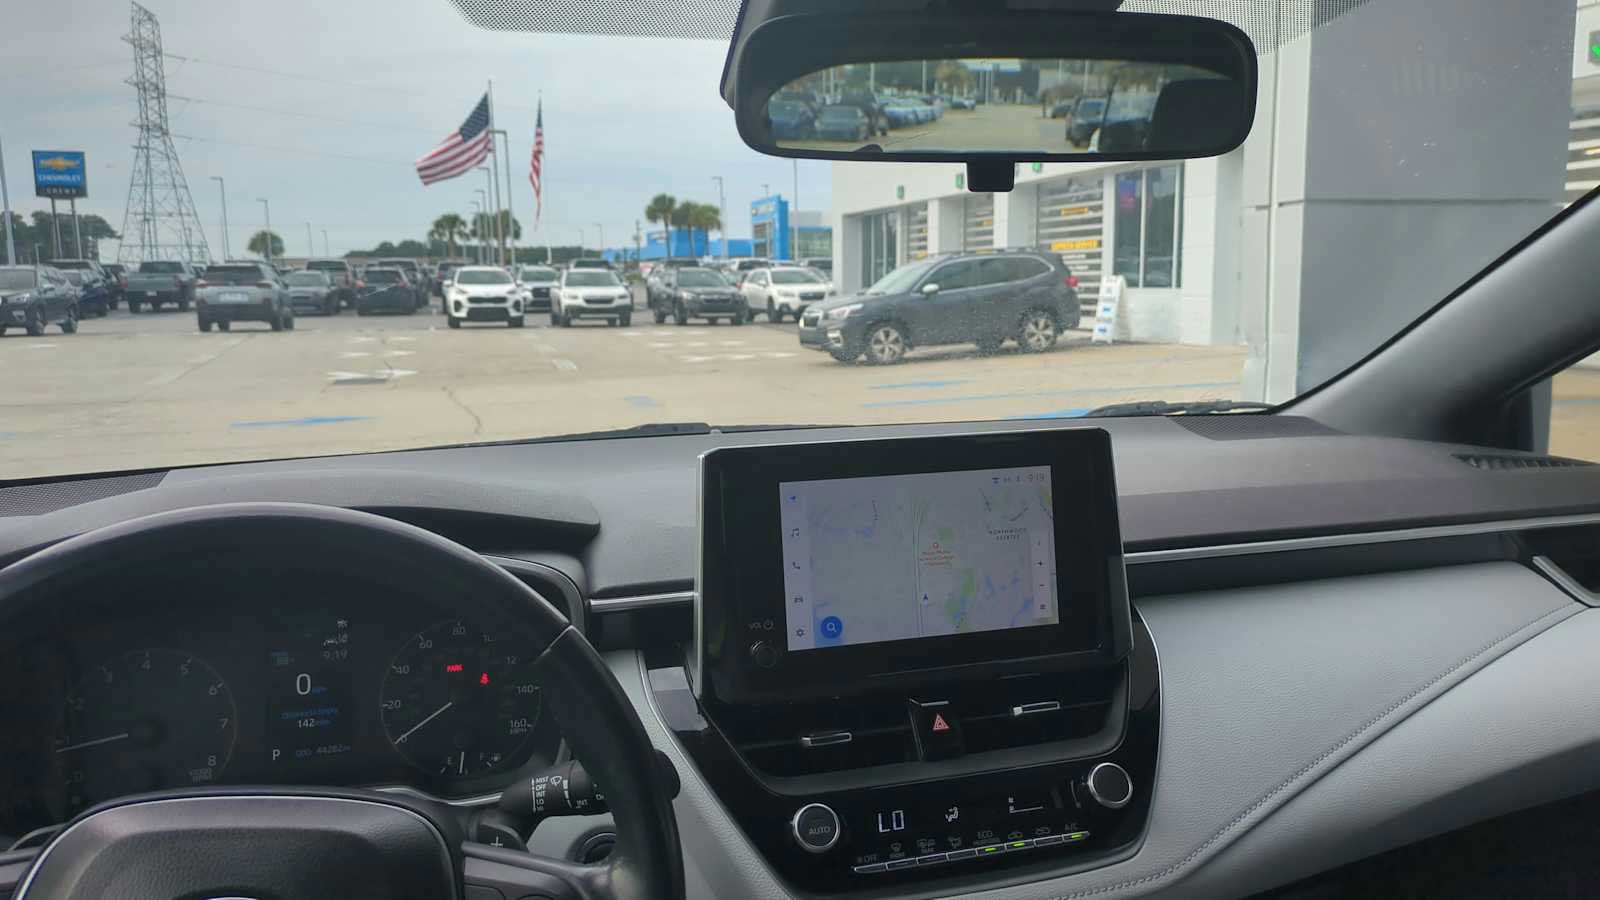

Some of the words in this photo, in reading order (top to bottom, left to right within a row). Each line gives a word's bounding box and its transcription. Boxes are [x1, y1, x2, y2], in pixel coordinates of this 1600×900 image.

[296, 673, 312, 695] 0
[208, 685, 218, 695] 6
[219, 718, 229, 729] 7
[272, 749, 280, 760] P
[207, 755, 217, 767] 8
[809, 825, 831, 835] AUTO
